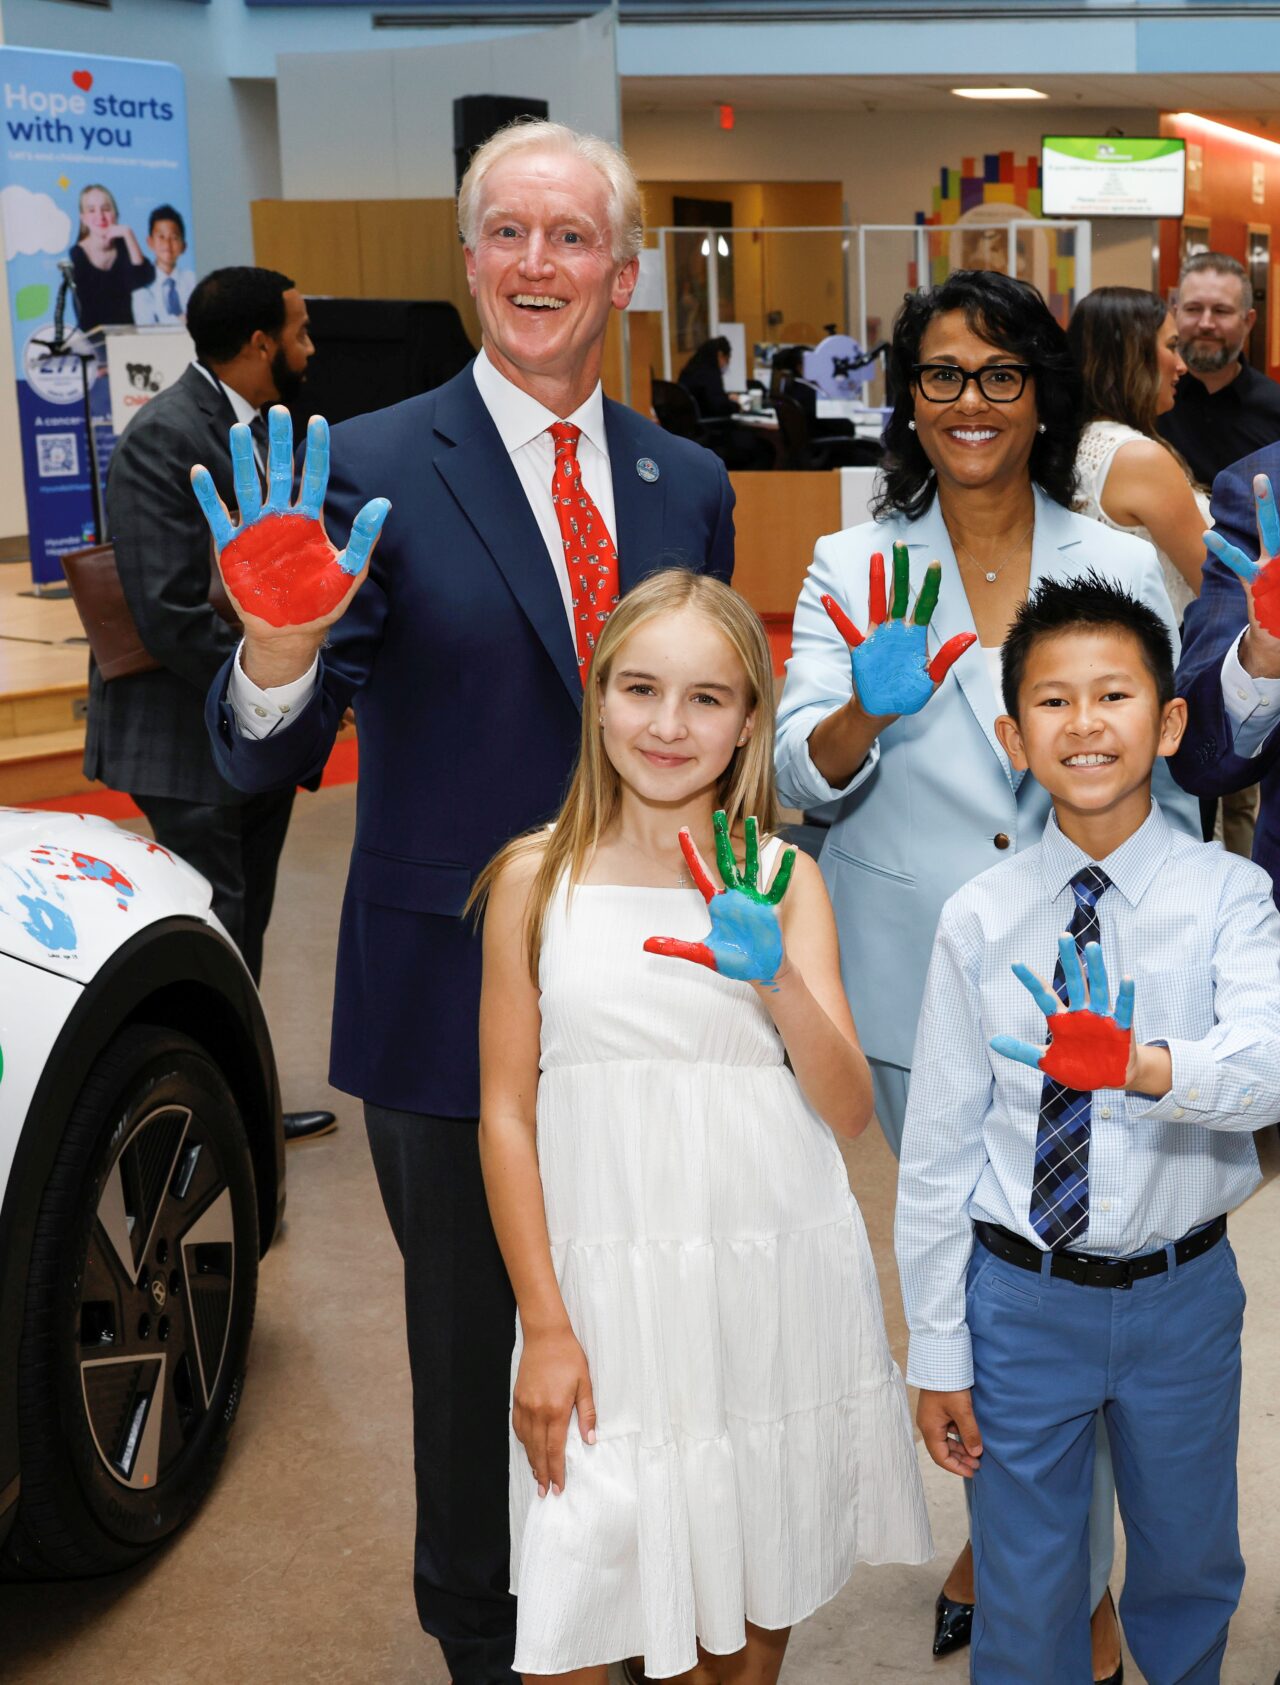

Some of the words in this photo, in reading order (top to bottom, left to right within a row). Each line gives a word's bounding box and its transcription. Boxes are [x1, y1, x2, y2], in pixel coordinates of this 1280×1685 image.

[4, 84, 86, 117] Hope
[94, 94, 173, 121] starts
[7, 116, 73, 144] with
[81, 126, 132, 151] you
[34, 416, 44, 427] A
